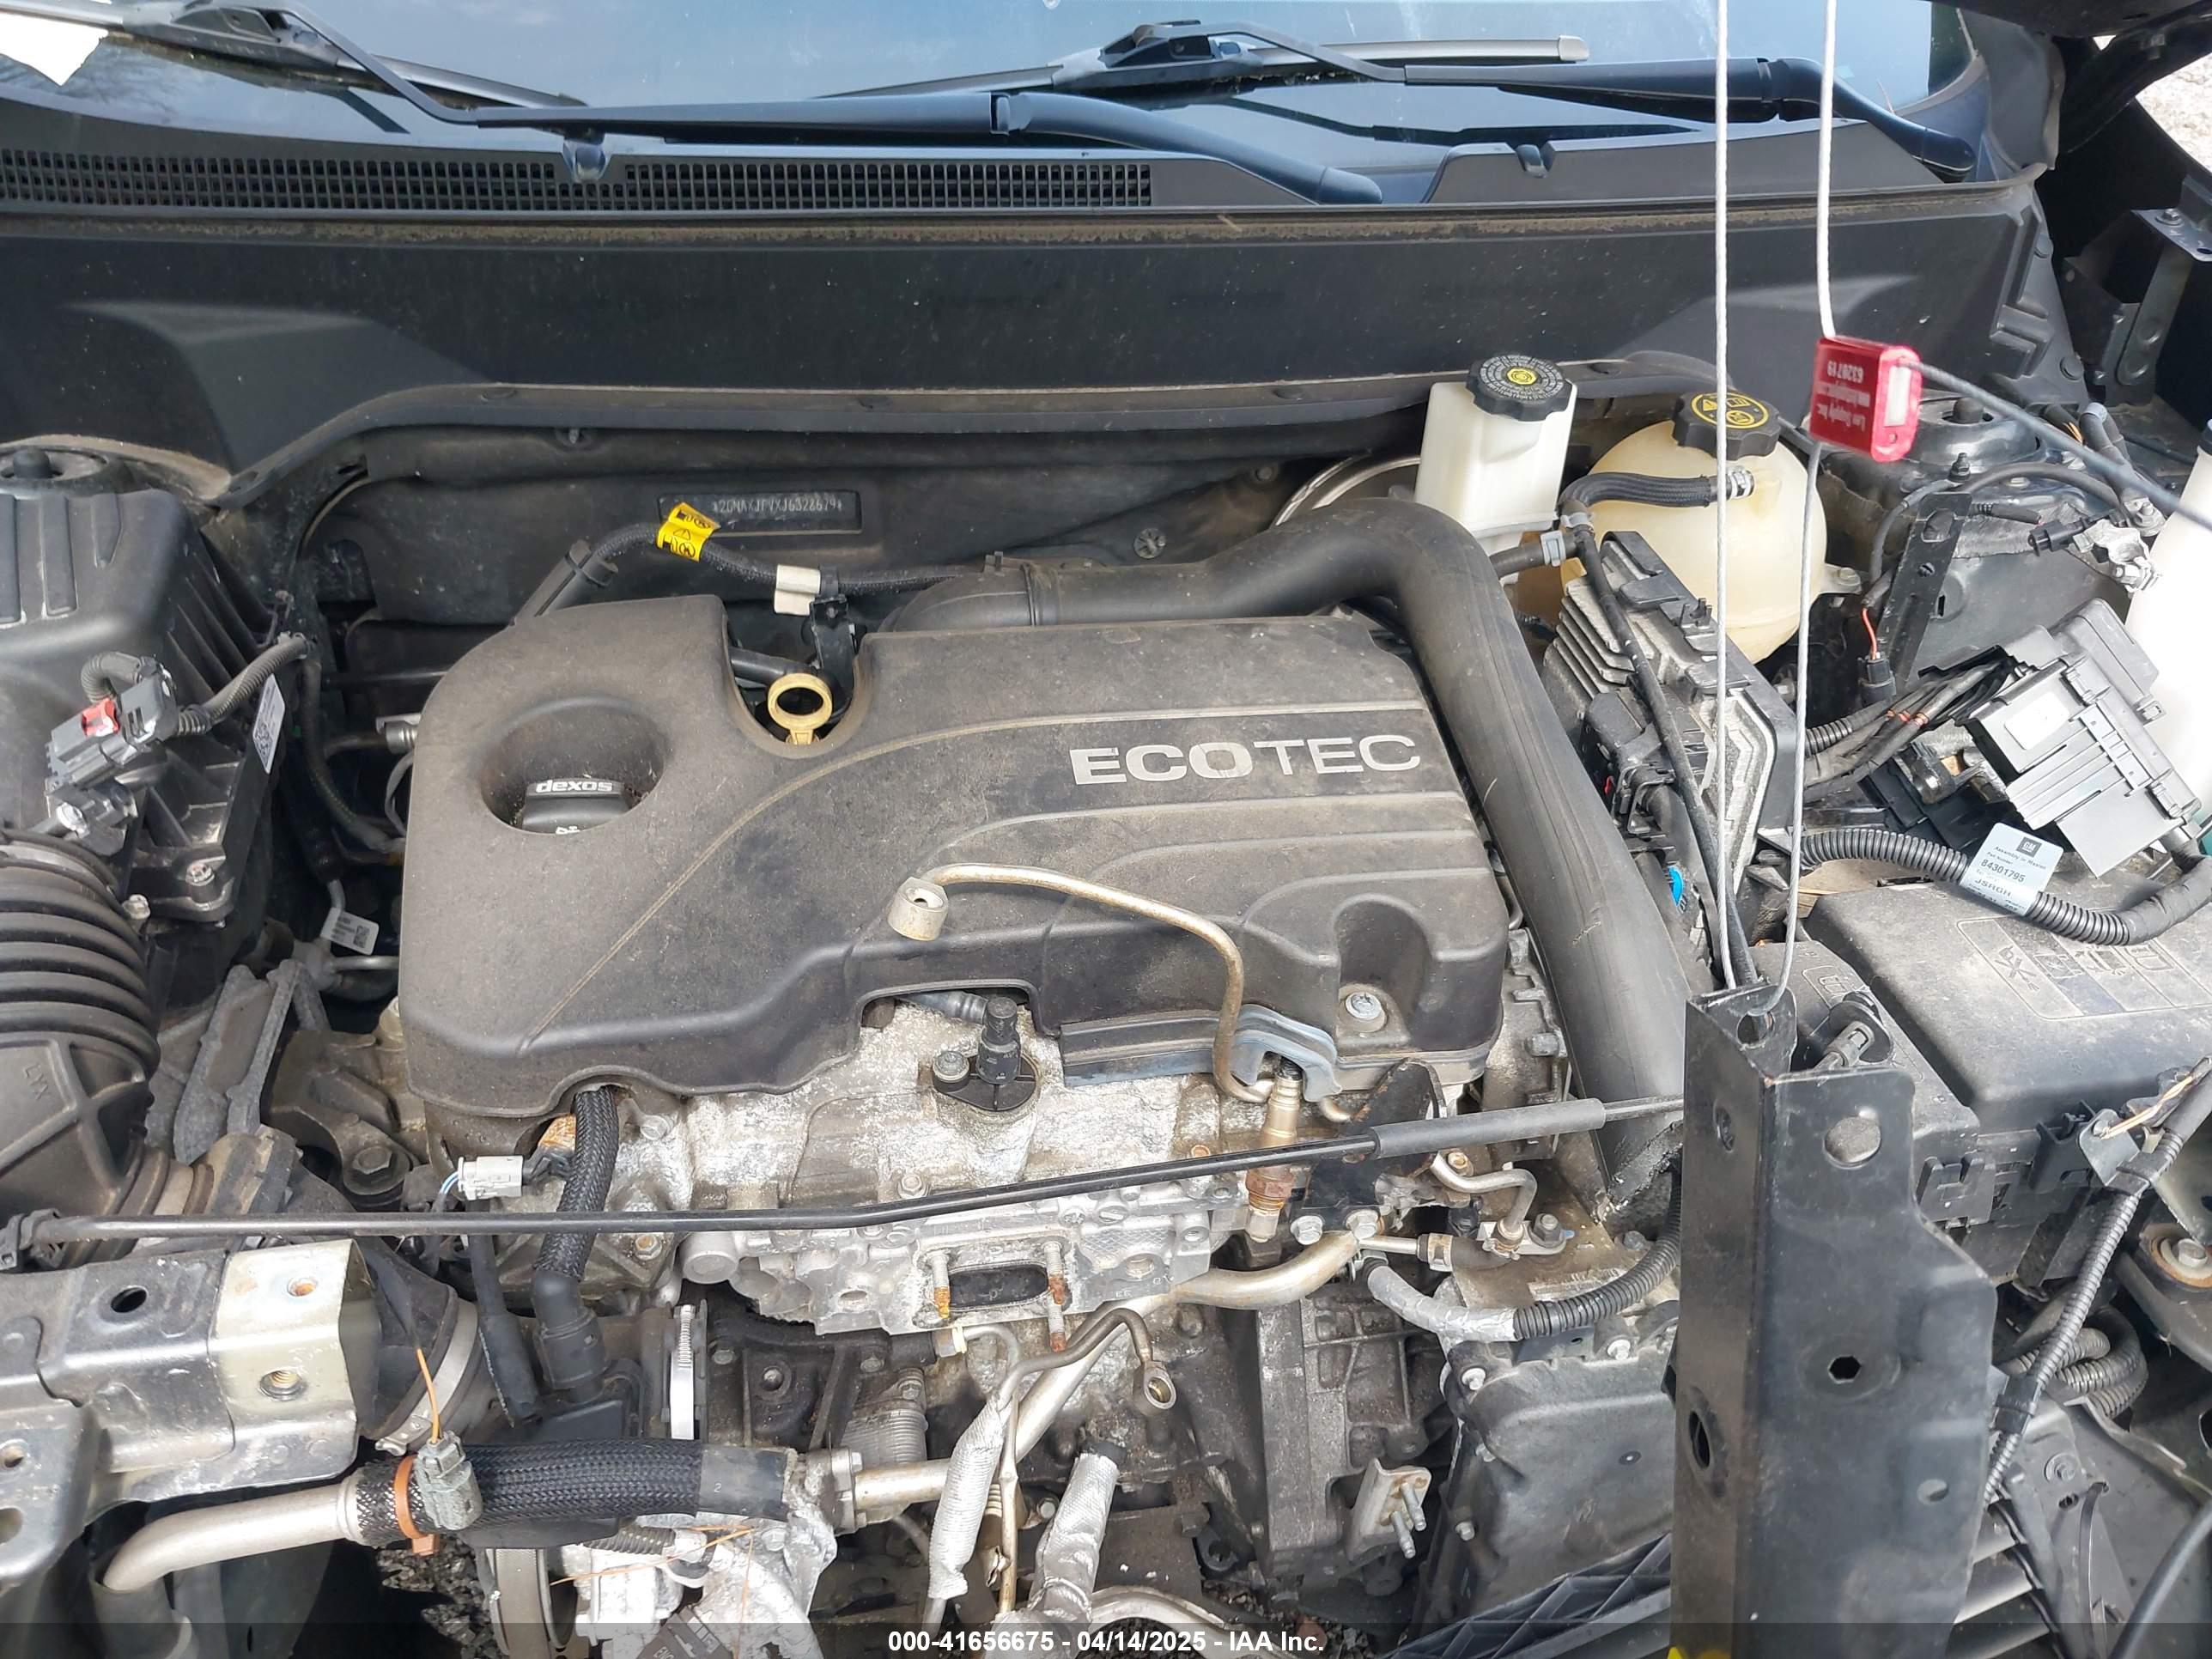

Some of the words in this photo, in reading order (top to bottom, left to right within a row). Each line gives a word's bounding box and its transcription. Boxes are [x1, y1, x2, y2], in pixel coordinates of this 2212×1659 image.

[1069, 734, 1421, 785] ECOTEC
[535, 779, 613, 793] dexos
[2024, 841, 2037, 852] GM
[1980, 859, 2027, 883] 84301795
